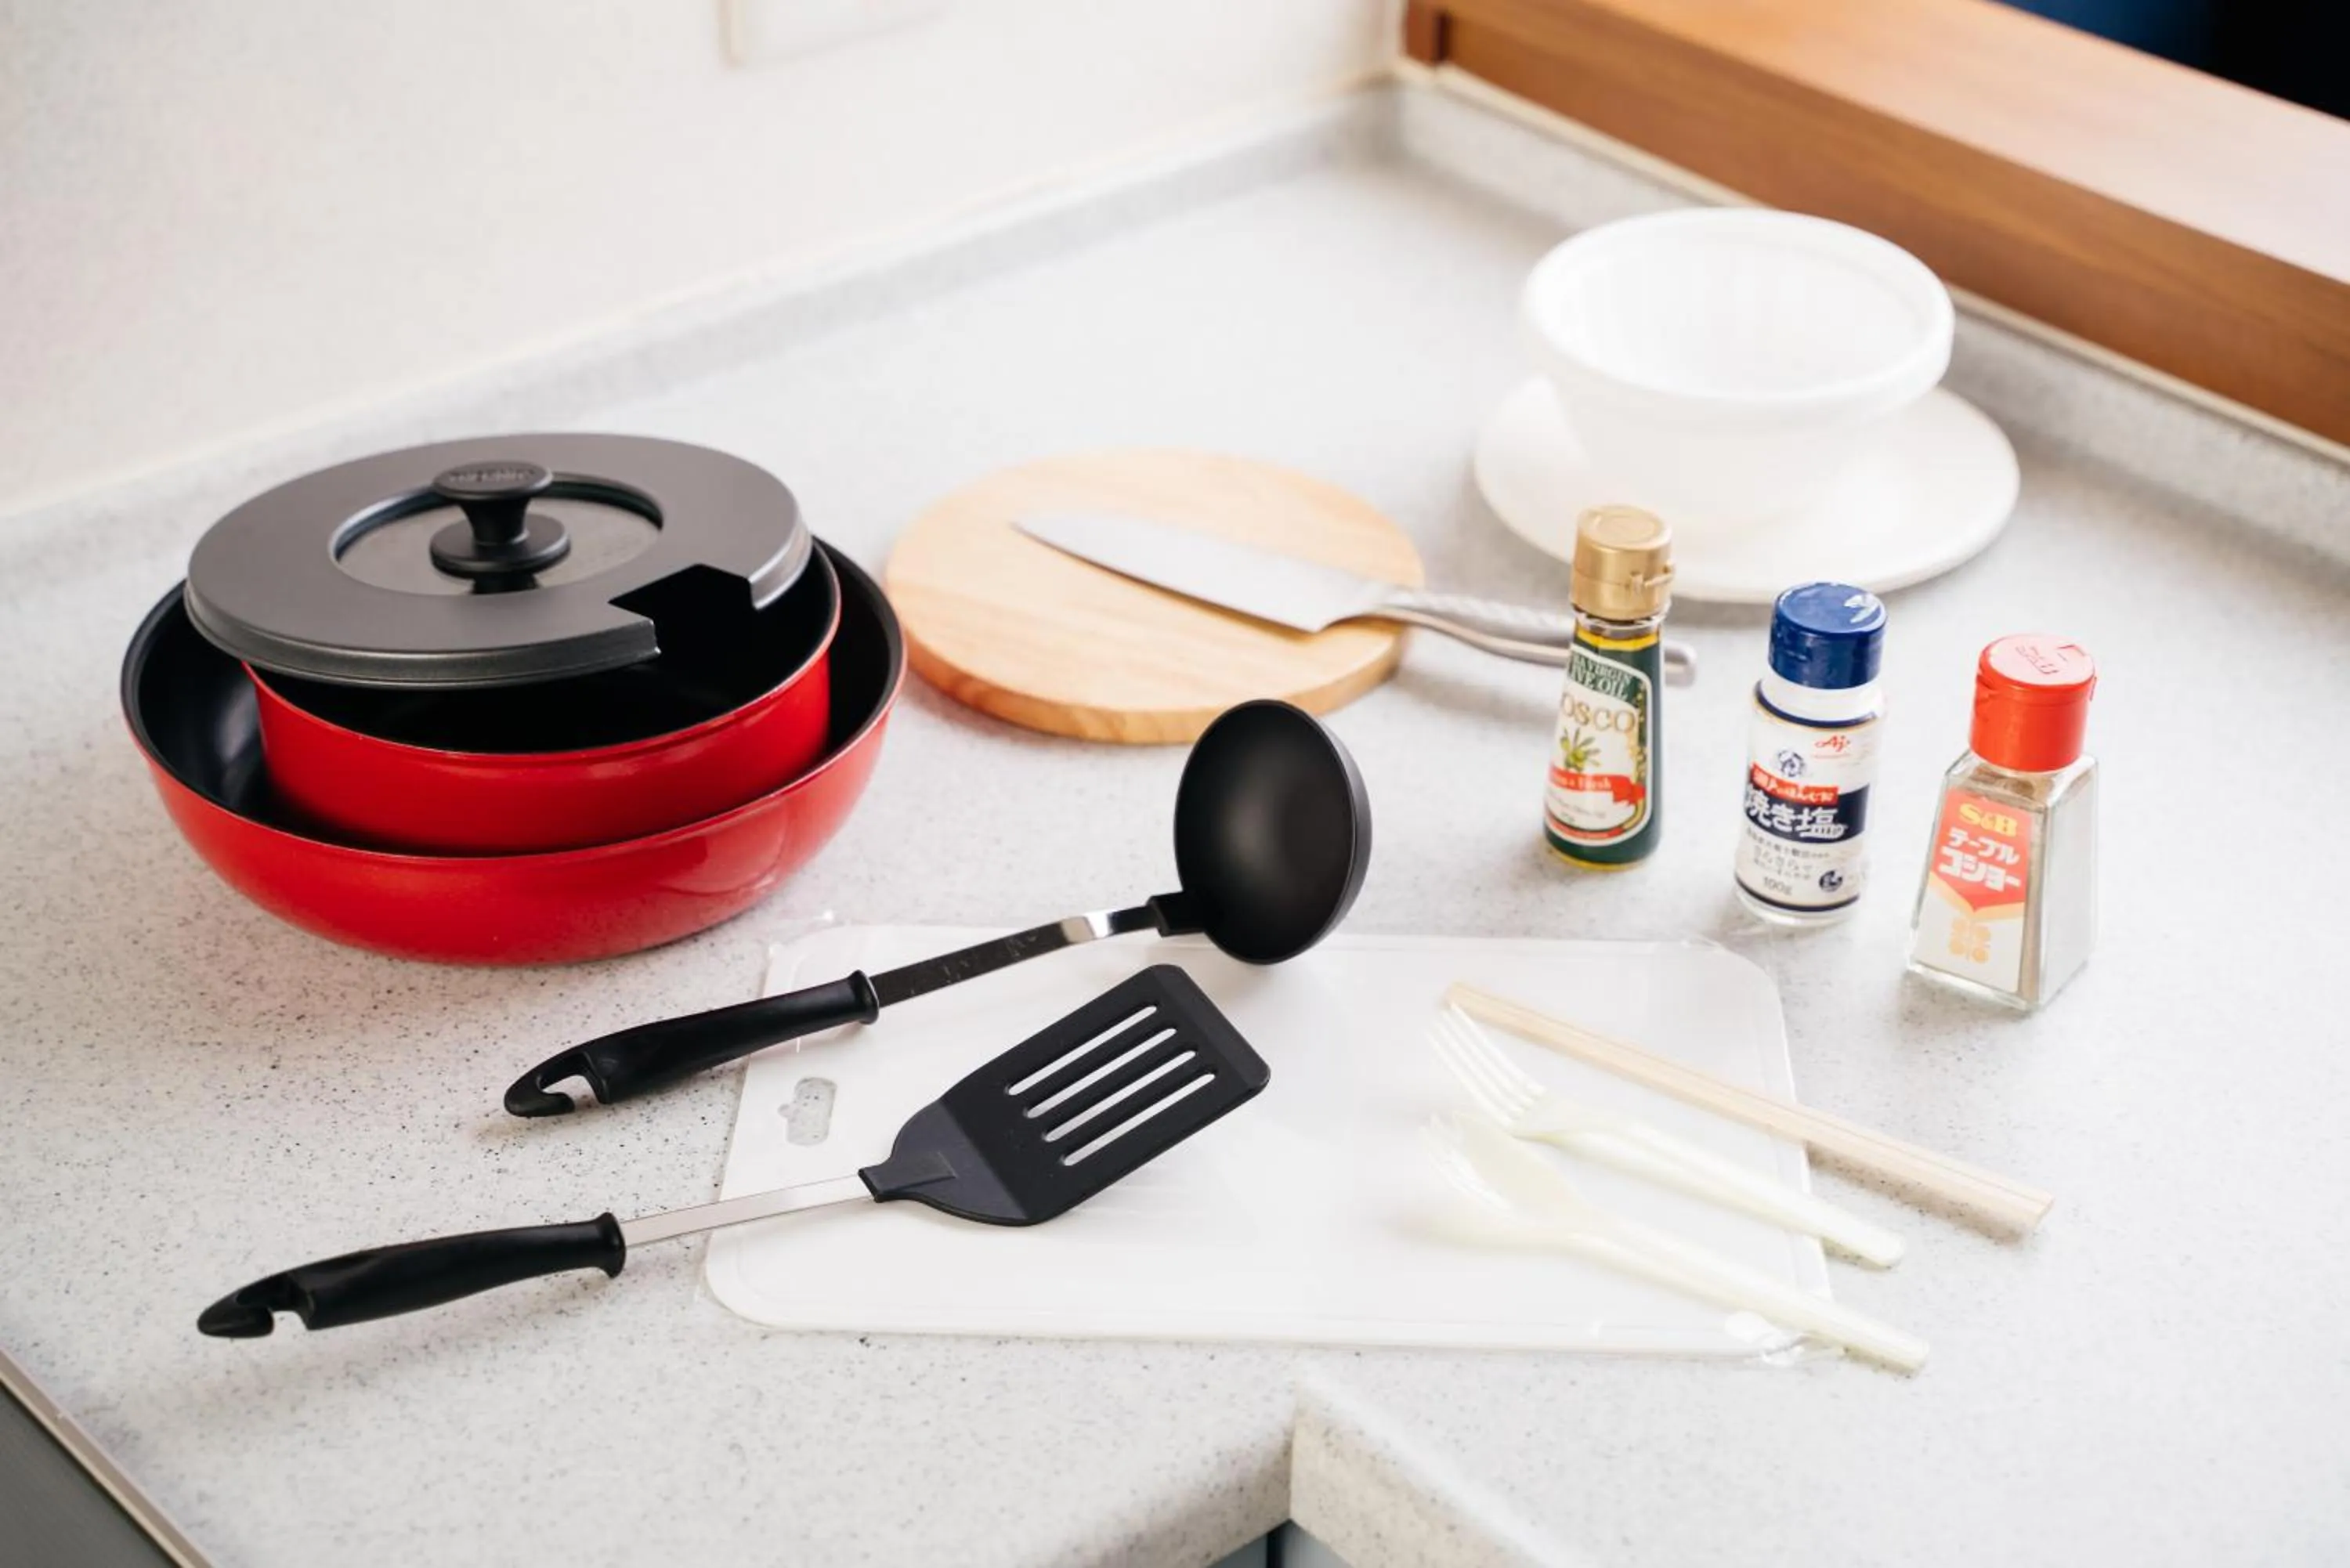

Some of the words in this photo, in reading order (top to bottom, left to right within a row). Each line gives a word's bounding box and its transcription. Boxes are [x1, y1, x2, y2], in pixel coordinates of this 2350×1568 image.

[1598, 677, 1628, 702] OIL
[1562, 692, 1636, 734] OSCO
[1959, 803, 2018, 837] S&B
[1937, 845, 2022, 892] コショー
